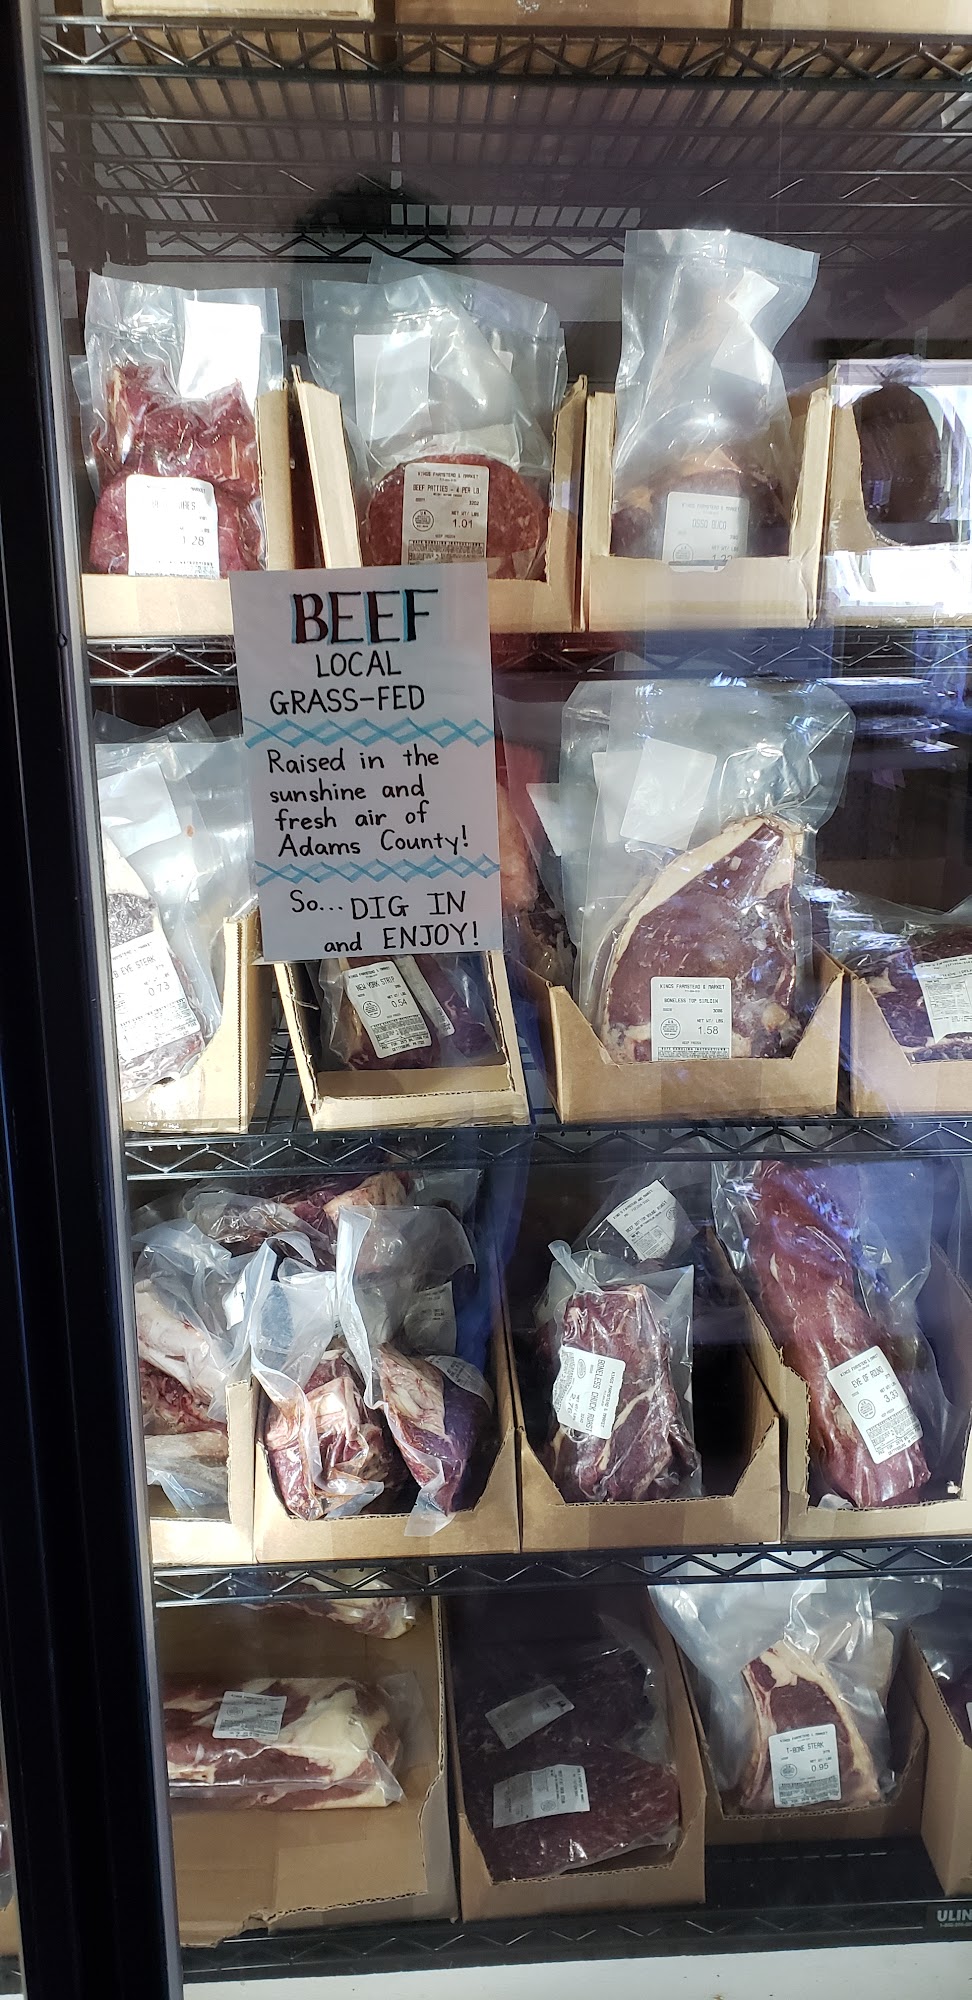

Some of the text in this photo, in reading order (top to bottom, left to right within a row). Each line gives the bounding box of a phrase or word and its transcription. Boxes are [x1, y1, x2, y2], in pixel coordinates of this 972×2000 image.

[453, 518, 473, 528] 1.01
[692, 519, 708, 528] OSSO
[183, 536, 204, 546] 128
[291, 589, 438, 645] BEEF
[316, 650, 402, 678] LOCAL
[270, 685, 425, 715] GRASS-FED
[268, 744, 439, 773] Raised in the
[270, 775, 425, 804] sunshine and
[275, 800, 429, 832] fresh air of
[278, 825, 469, 857] Adams County!
[291, 890, 466, 920] So... DIG IN
[324, 921, 479, 954] and ENJOY!
[120, 964, 134, 976] EYE
[135, 955, 156, 969] STEAK
[148, 981, 170, 997] 073
[355, 983, 367, 991] NEW
[367, 981, 380, 989] YORK
[380, 976, 395, 986] STRIP
[391, 998, 408, 1008] 0.54
[698, 1026, 719, 1035] 1.58
[593, 1359, 606, 1390] BONELESS
[851, 1378, 863, 1388] EYE
[862, 1374, 869, 1382] OF
[870, 1366, 884, 1378] ROUND
[589, 1391, 599, 1411] CHUCK
[883, 1389, 899, 1403] 3.33
[585, 1413, 594, 1432] ROAST
[786, 1742, 824, 1754] T-BONE STEAK
[811, 1763, 829, 1772] 095
[937, 1909, 972, 1922] ULIN
